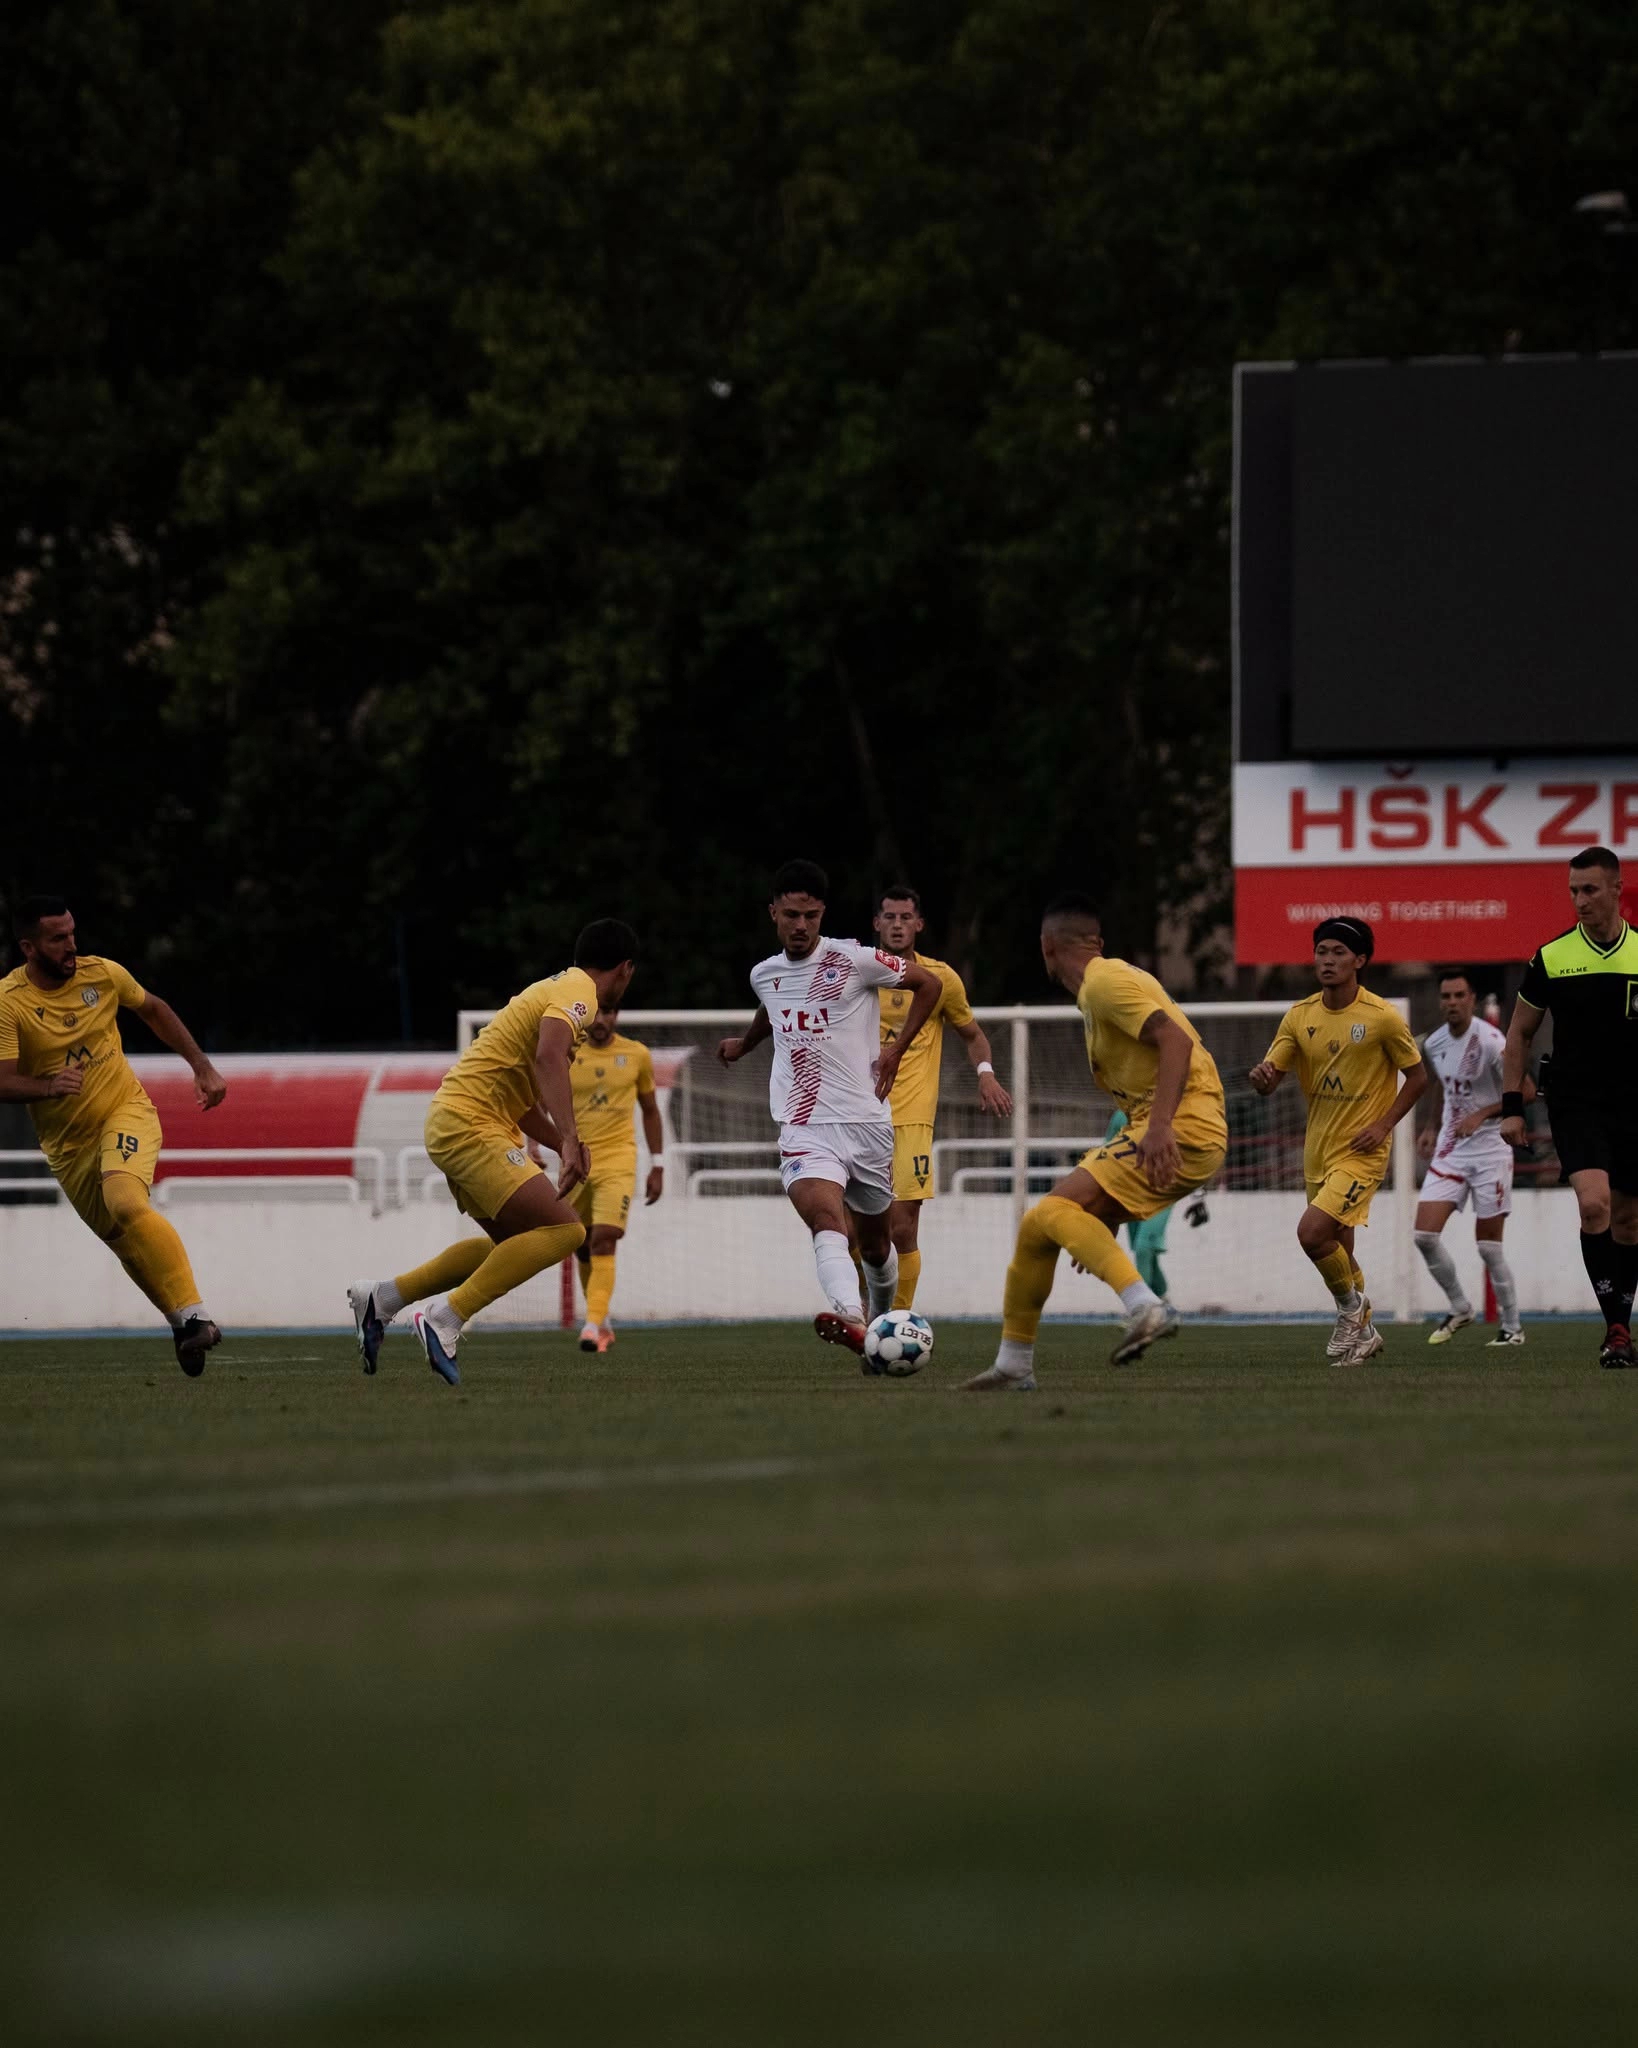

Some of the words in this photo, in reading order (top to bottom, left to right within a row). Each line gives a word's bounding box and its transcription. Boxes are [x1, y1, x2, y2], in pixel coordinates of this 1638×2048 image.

[1288, 763, 1509, 851] HŠK
[1286, 902, 1384, 923] WINNING
[1388, 899, 1508, 921] TOGETHER!
[1559, 966, 1588, 975] KELME
[116, 1132, 139, 1153] 19
[913, 1155, 929, 1176] 17
[900, 1327, 932, 1346] SELECT
